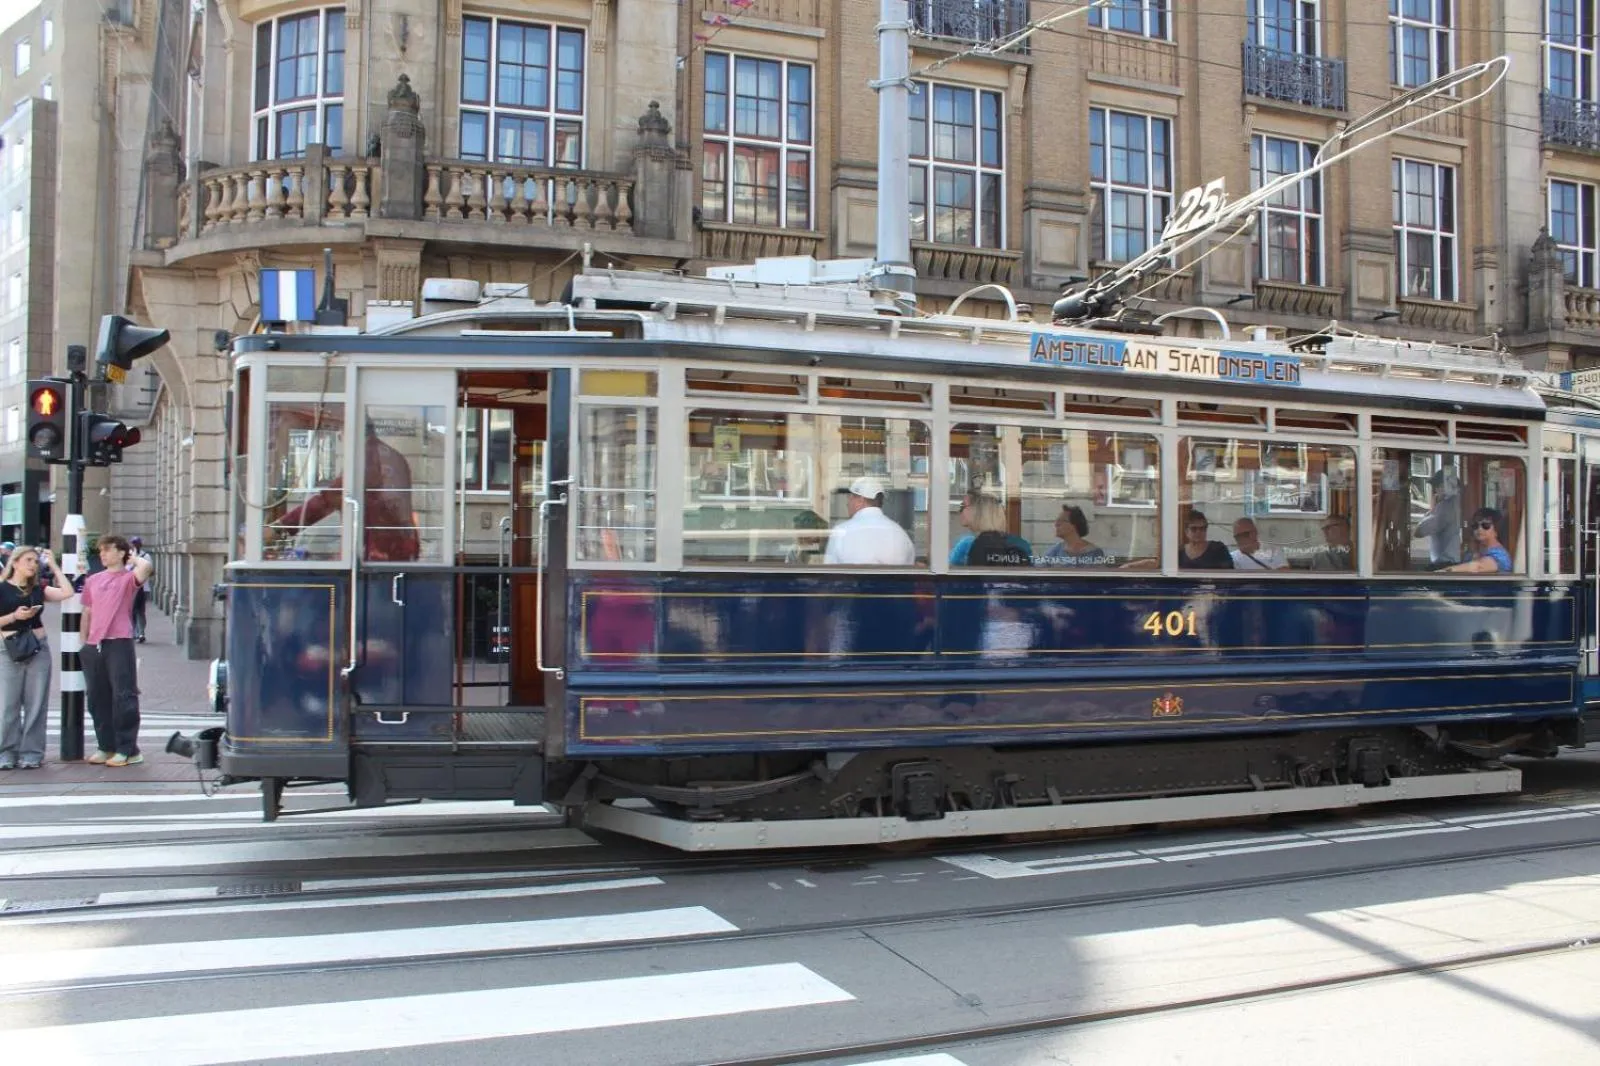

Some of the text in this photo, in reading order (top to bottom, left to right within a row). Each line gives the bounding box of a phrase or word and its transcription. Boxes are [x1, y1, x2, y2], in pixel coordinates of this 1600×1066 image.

[1166, 176, 1225, 240] 25
[1033, 335, 1300, 382] AMSTELLAAN STATIONSPLEIN
[1143, 611, 1197, 636] 401
